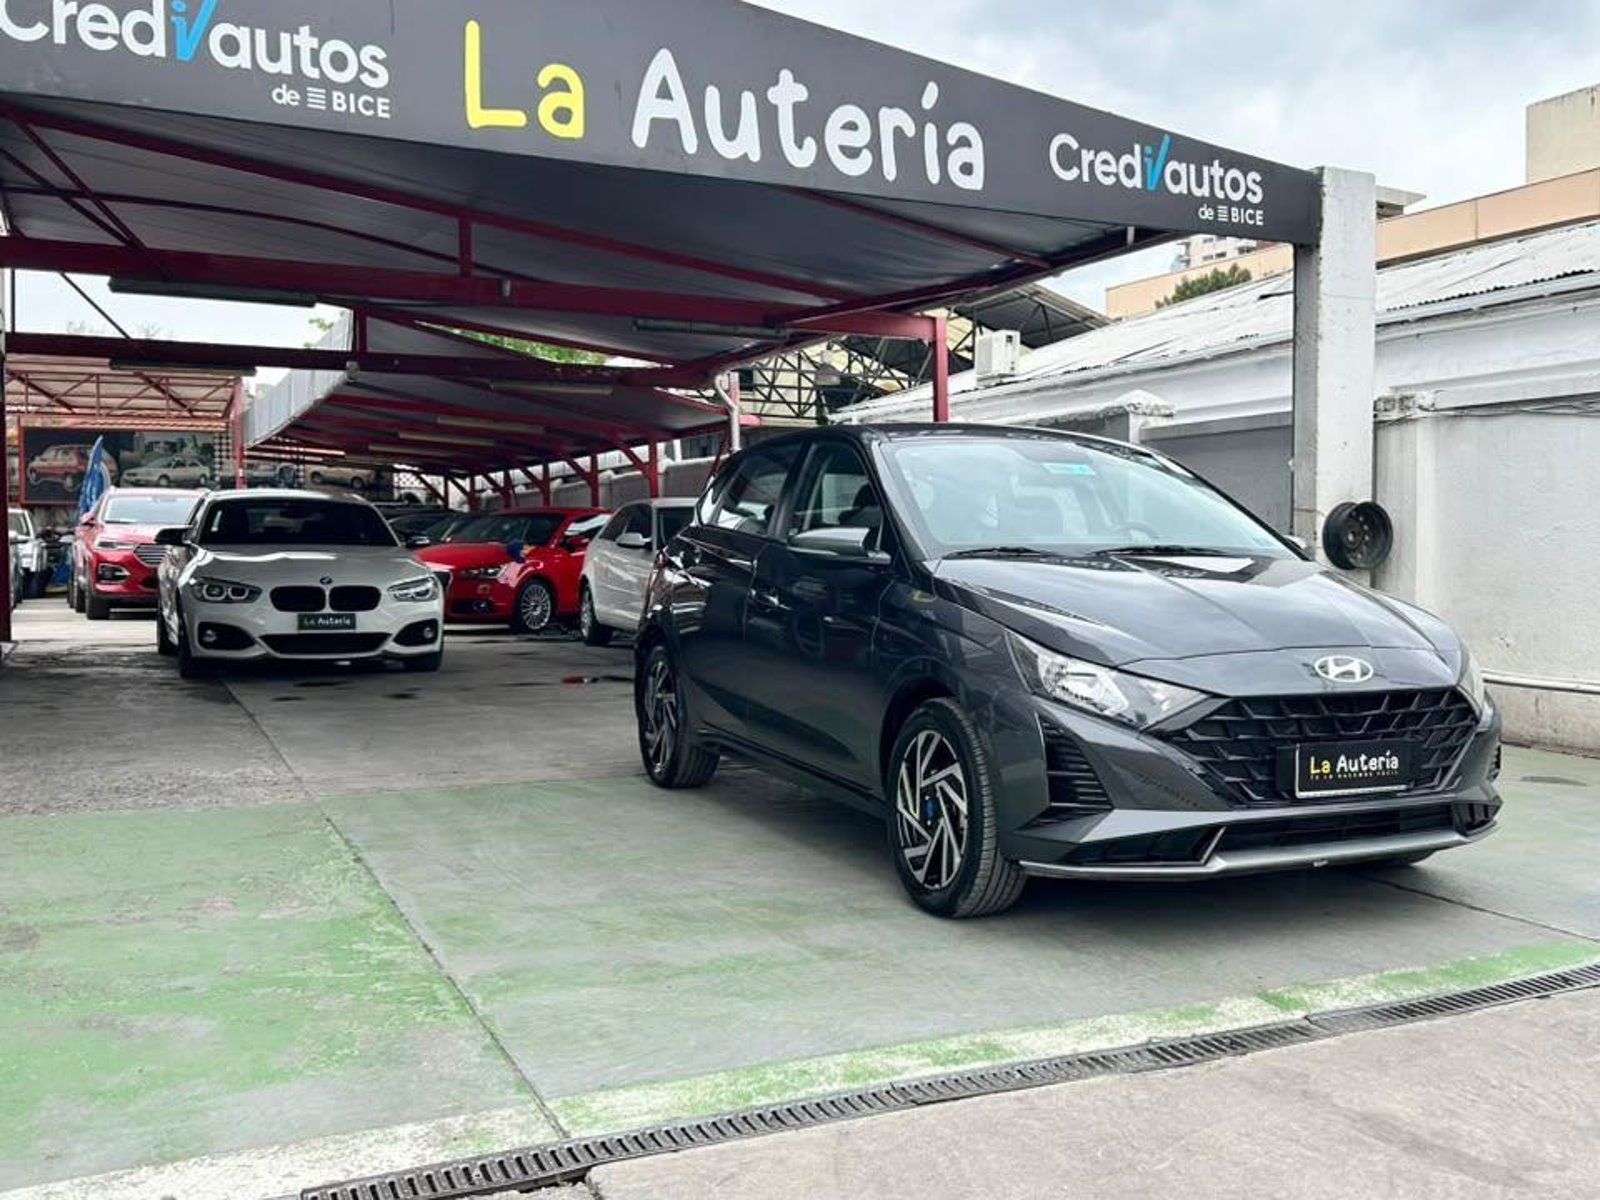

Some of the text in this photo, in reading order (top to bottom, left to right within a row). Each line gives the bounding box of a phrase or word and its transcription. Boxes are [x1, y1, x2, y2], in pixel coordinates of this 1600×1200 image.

[272, 84, 391, 118] de BICE
[465, 20, 984, 190] La Autería
[1198, 204, 1264, 226] de BICE
[1310, 751, 1399, 773] La Autería
